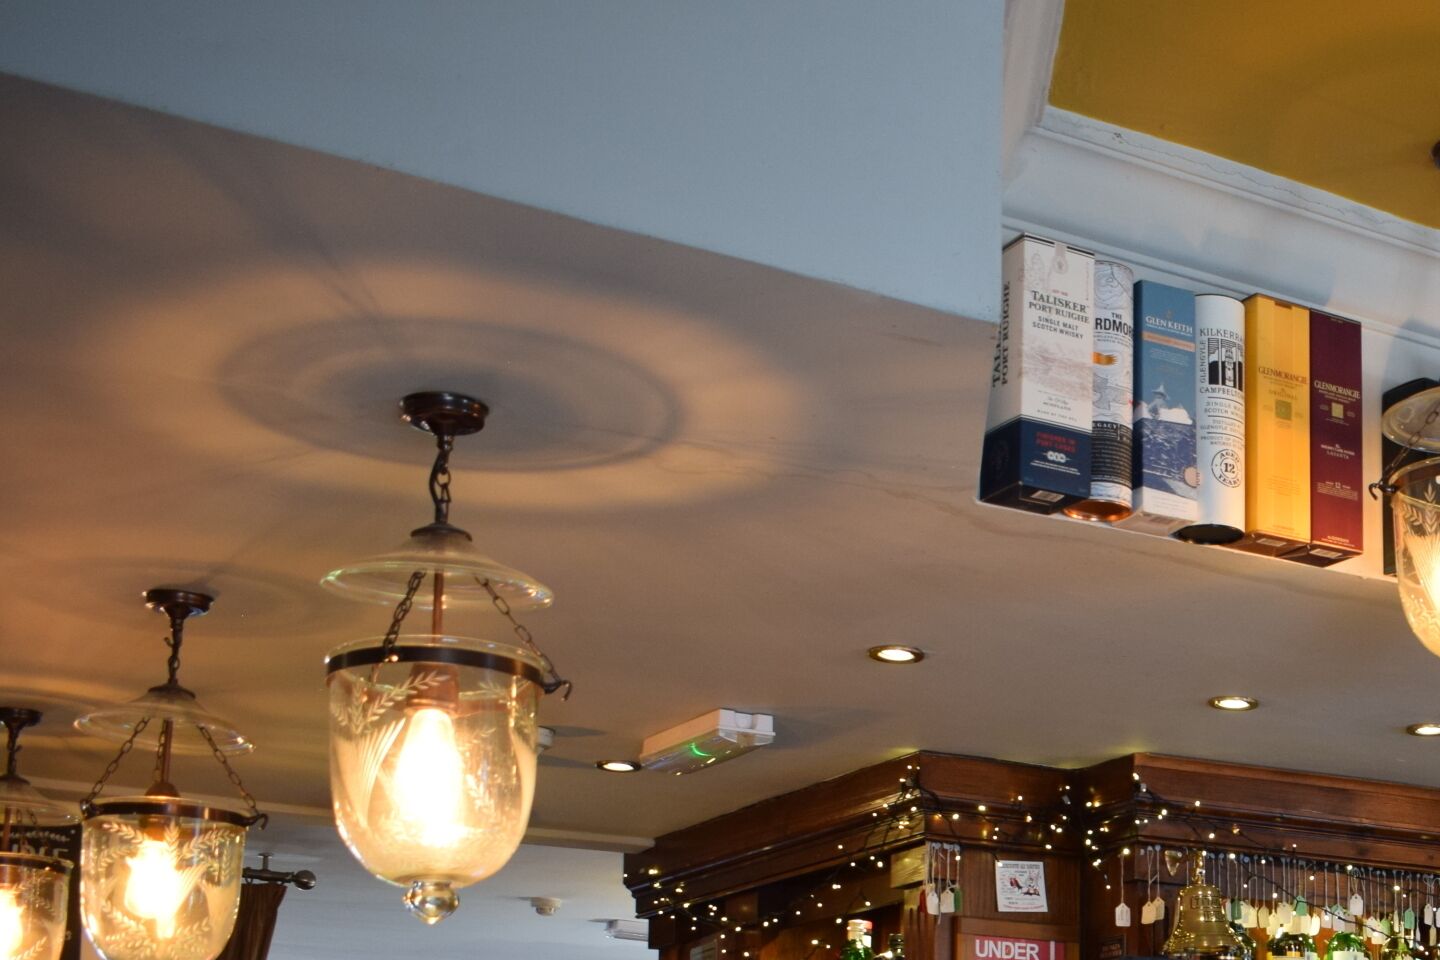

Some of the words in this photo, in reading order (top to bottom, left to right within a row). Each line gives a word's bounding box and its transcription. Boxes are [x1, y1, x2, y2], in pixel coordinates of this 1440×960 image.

[1031, 290, 1087, 314] TALISKER
[1028, 302, 1052, 314] PORT
[1055, 308, 1090, 324] RUIGHE
[1032, 322, 1058, 333] SCOTCH
[1059, 329, 1084, 339] WHISKY
[1038, 316, 1061, 327] SINGLE
[1062, 322, 1079, 331] MALT
[1095, 318, 1132, 337] RDMOR
[1145, 315, 1167, 328] GLEN
[1168, 320, 1193, 334] KEITH
[1258, 366, 1308, 385] GLENMORANGIE
[1314, 380, 1361, 400] GLENMORANGIE
[1223, 462, 1236, 474] 12
